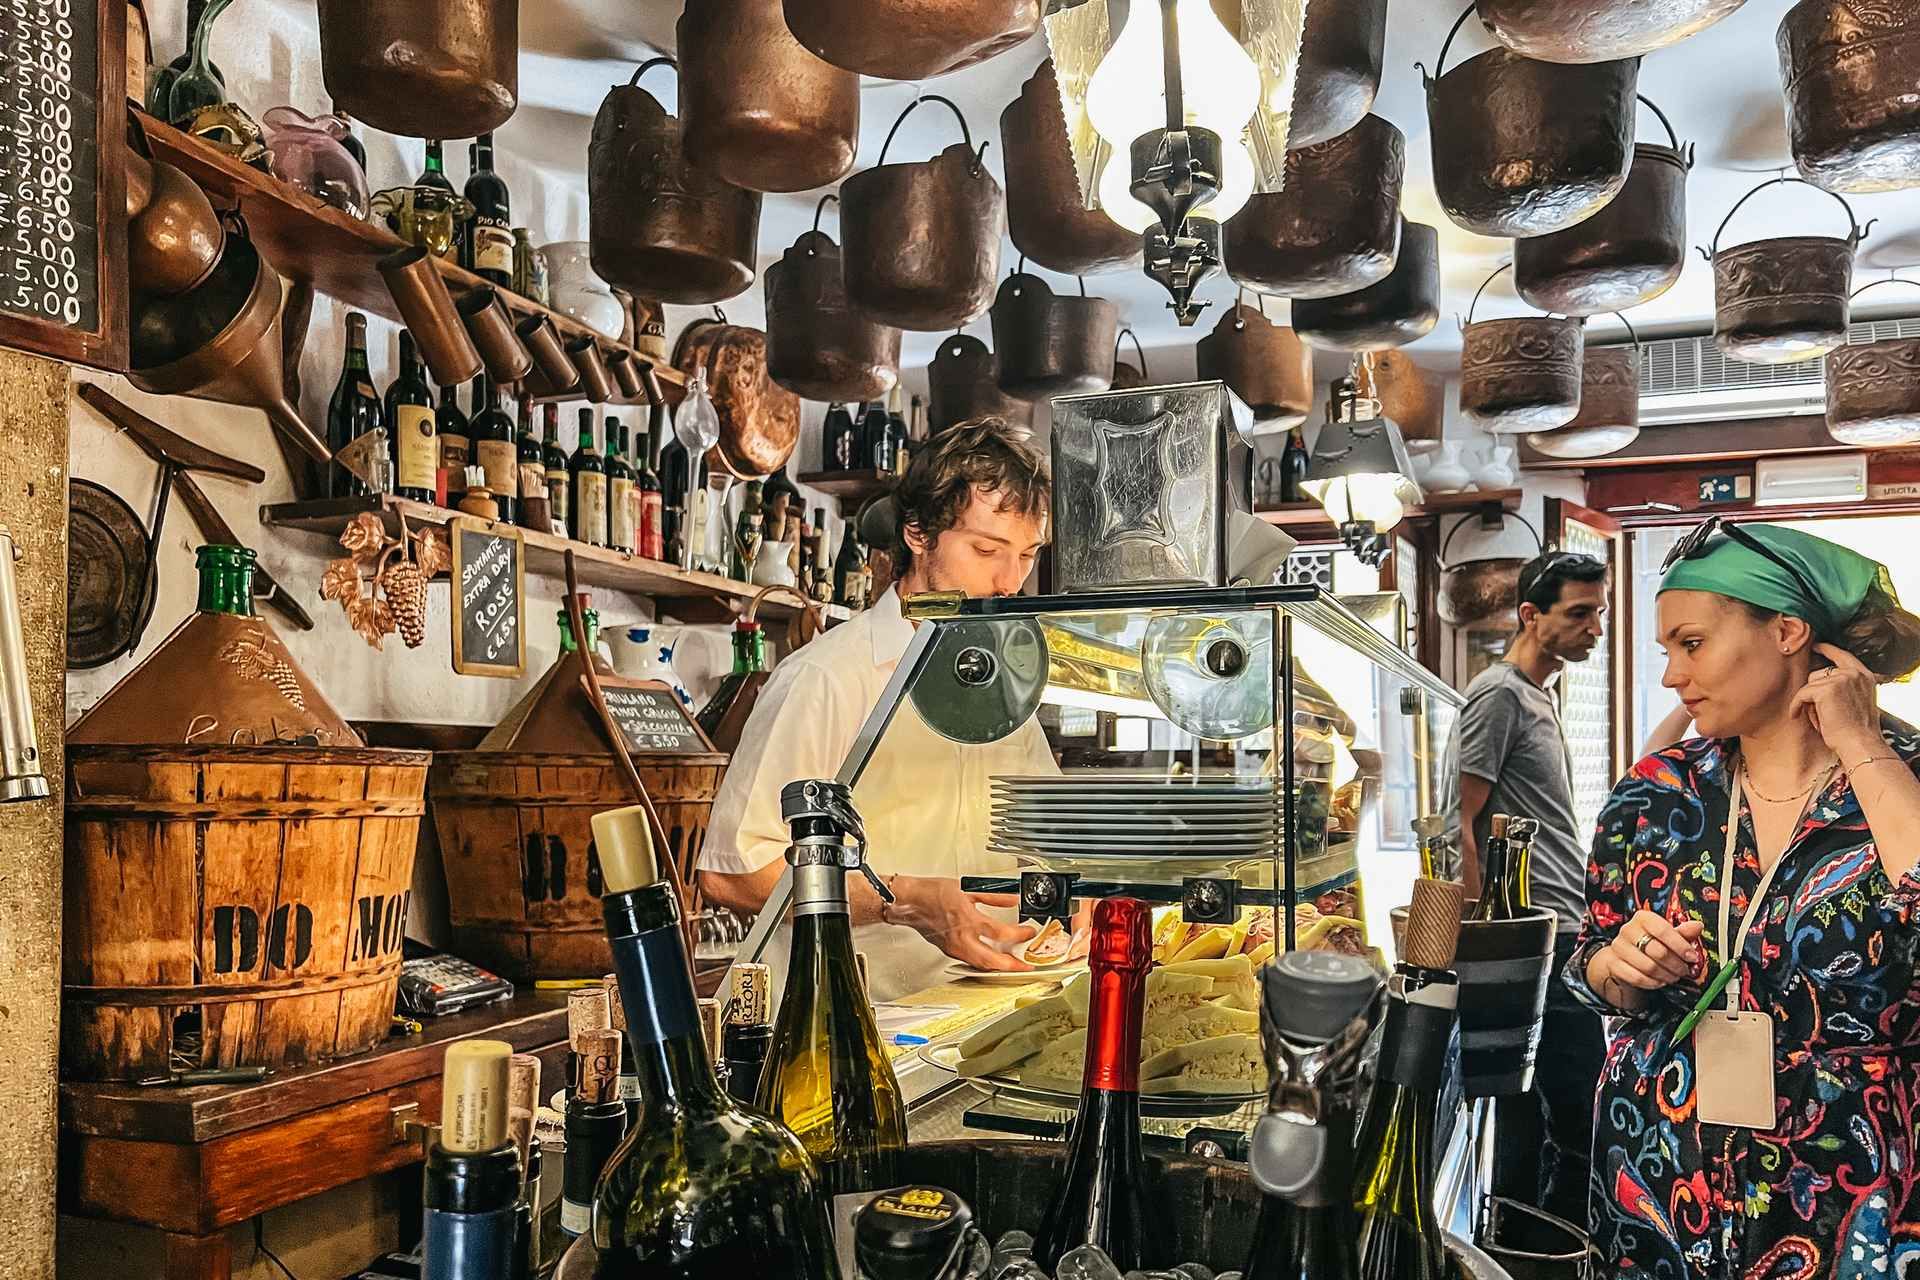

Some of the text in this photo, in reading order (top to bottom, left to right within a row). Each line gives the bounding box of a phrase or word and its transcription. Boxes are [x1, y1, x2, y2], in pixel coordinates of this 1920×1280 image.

[1883, 486, 1918, 496] USCITA
[462, 536, 503, 586] SPUMANTE
[463, 547, 511, 609] EXTRA DRY
[601, 690, 657, 706] RIULANO
[213, 902, 314, 974] DO
[742, 972, 754, 1023] RTORI
